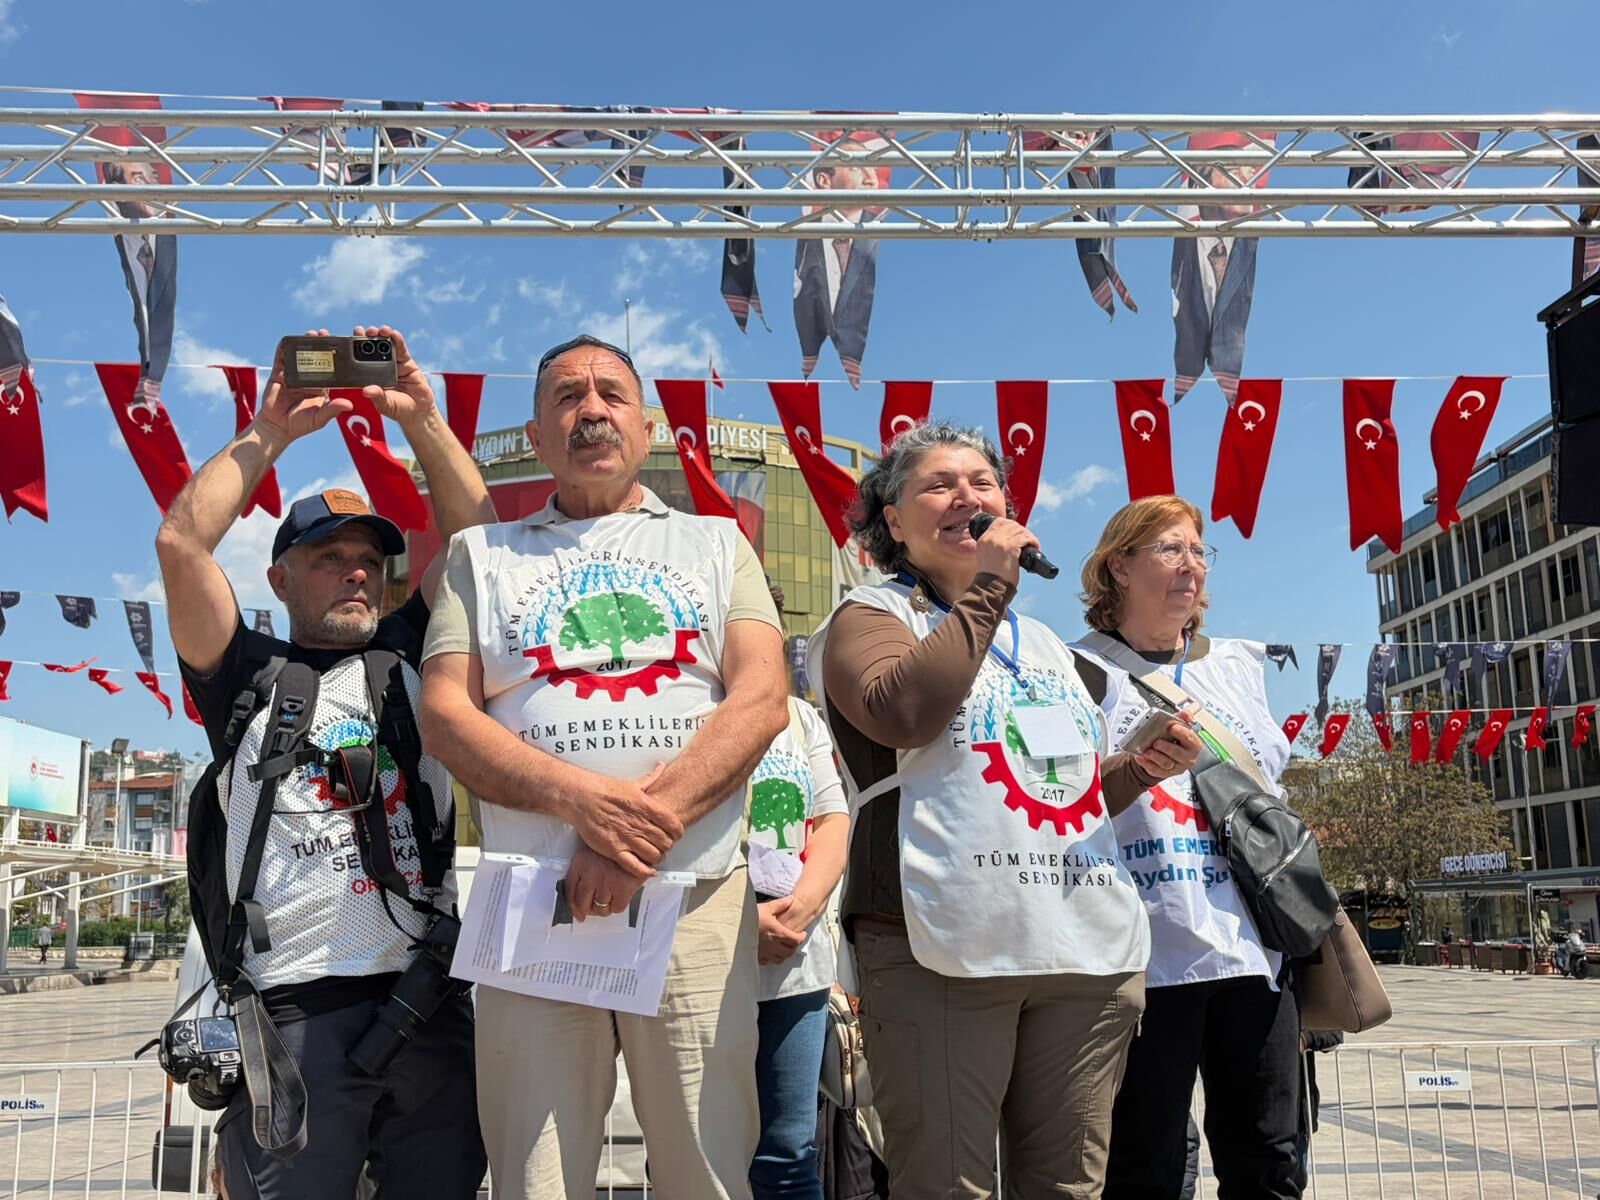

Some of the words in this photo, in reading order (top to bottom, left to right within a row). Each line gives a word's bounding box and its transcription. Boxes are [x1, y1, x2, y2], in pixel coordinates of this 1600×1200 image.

[505, 614, 521, 655] TÜM
[596, 660, 632, 672] 2017
[519, 724, 558, 742] TÜM
[568, 715, 705, 734] EMEKLİLERİ
[949, 706, 967, 748] TÜM
[555, 735, 682, 754] SENDİKASI
[1041, 788, 1065, 802] 2017
[1123, 838, 1165, 861] TÜM
[1172, 837, 1221, 857] EMEK
[974, 850, 1020, 867] TÜM
[1019, 870, 1113, 887] SENDİKASI
[1130, 863, 1198, 890] Aydın
[1202, 866, 1229, 888] Şu
[1418, 1075, 1451, 1086] POLİS
[1, 1098, 36, 1110] POLİS
